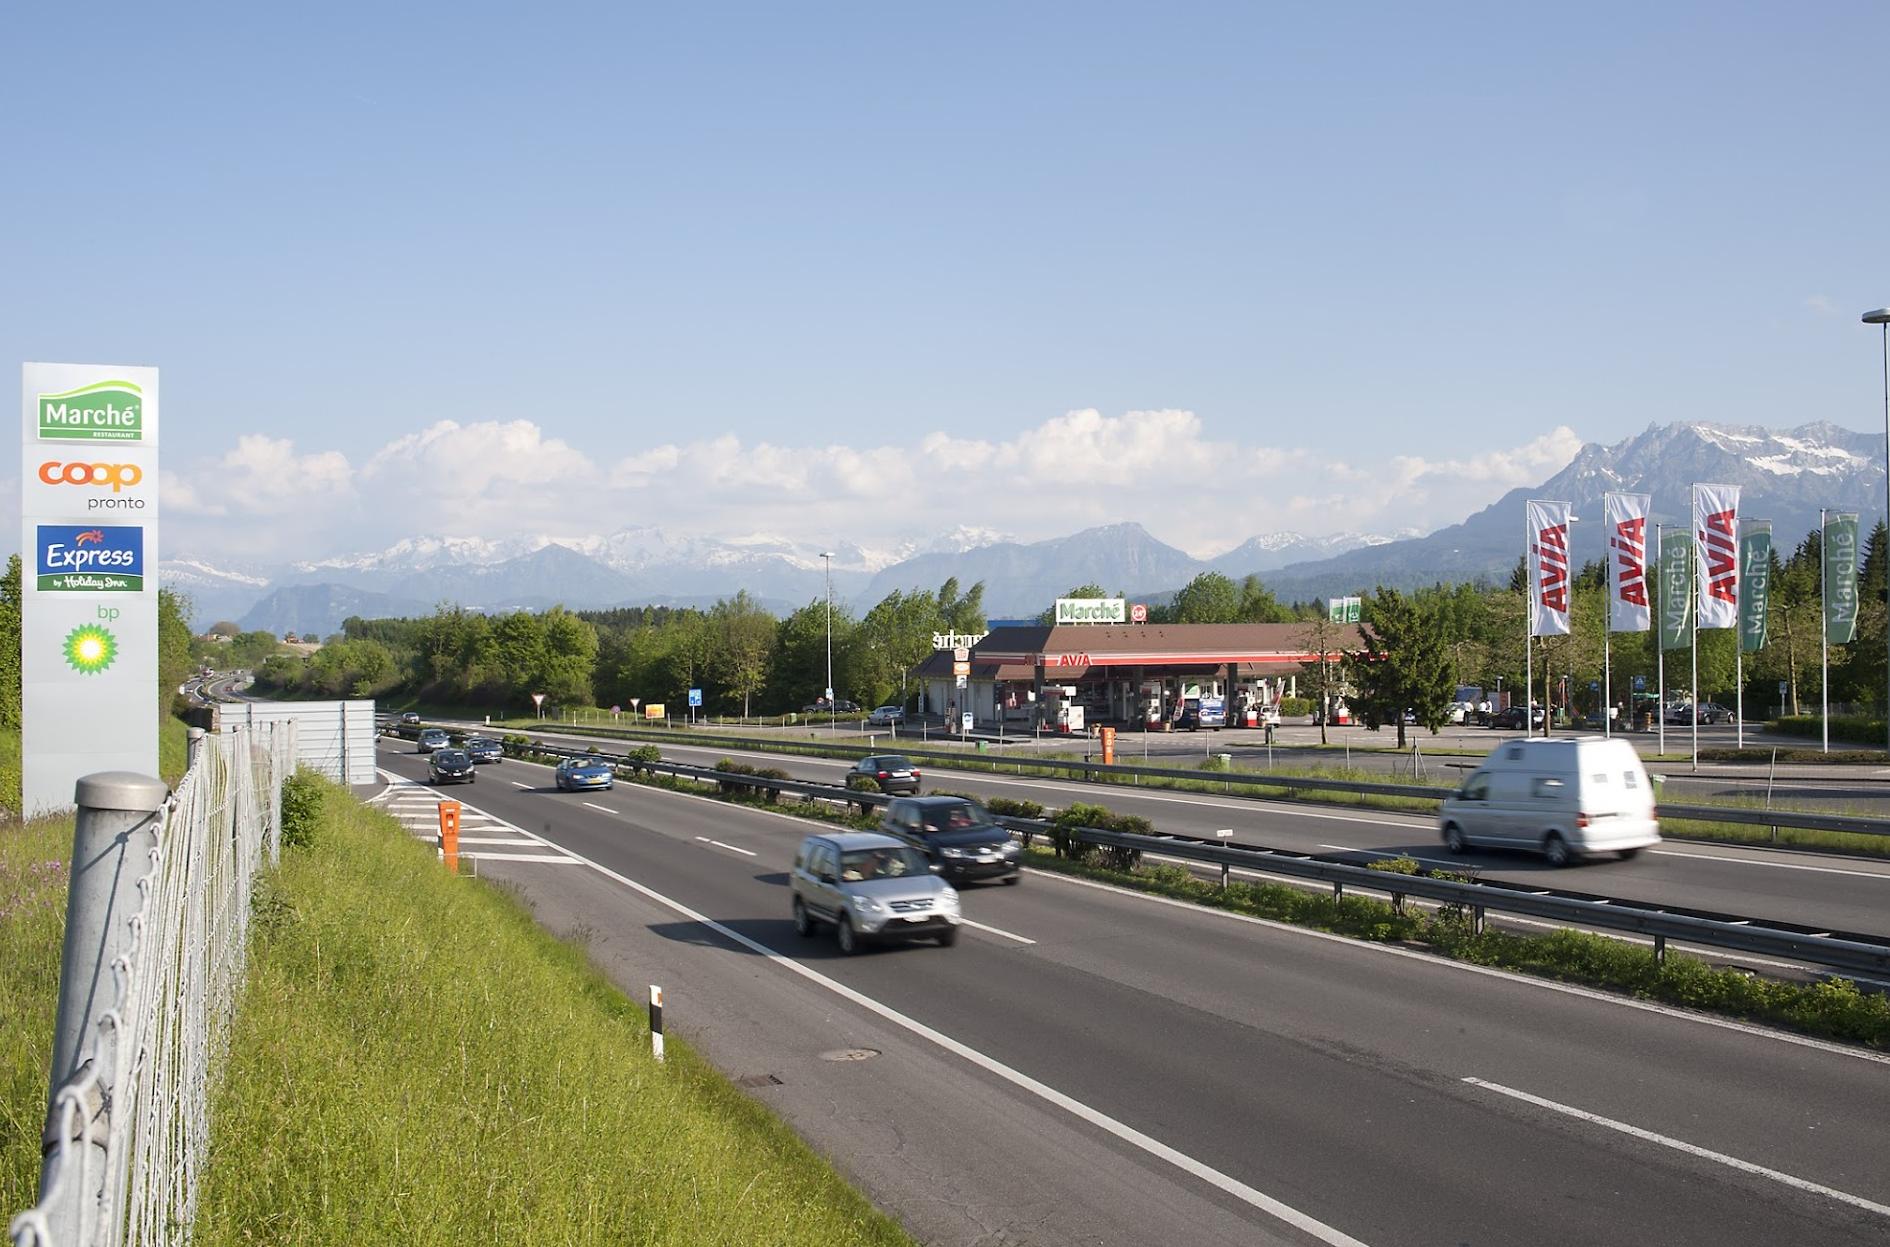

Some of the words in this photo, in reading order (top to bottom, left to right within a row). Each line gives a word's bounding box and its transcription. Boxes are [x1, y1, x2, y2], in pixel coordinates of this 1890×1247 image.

[46, 403, 135, 426] Marché
[39, 461, 142, 493] coop
[88, 497, 145, 511] pronto
[47, 543, 134, 572] Express
[1533, 524, 1567, 614] AVIA
[1611, 517, 1647, 607] AVIA
[1699, 509, 1736, 605] AVIA
[64, 576, 104, 589] Holiday
[105, 578, 127, 588] Inn
[1667, 546, 1686, 630] Marché
[1830, 533, 1854, 623] Marché
[97, 604, 120, 622] bp
[1060, 602, 1120, 620] Marché
[1057, 653, 1093, 666] AVIA
